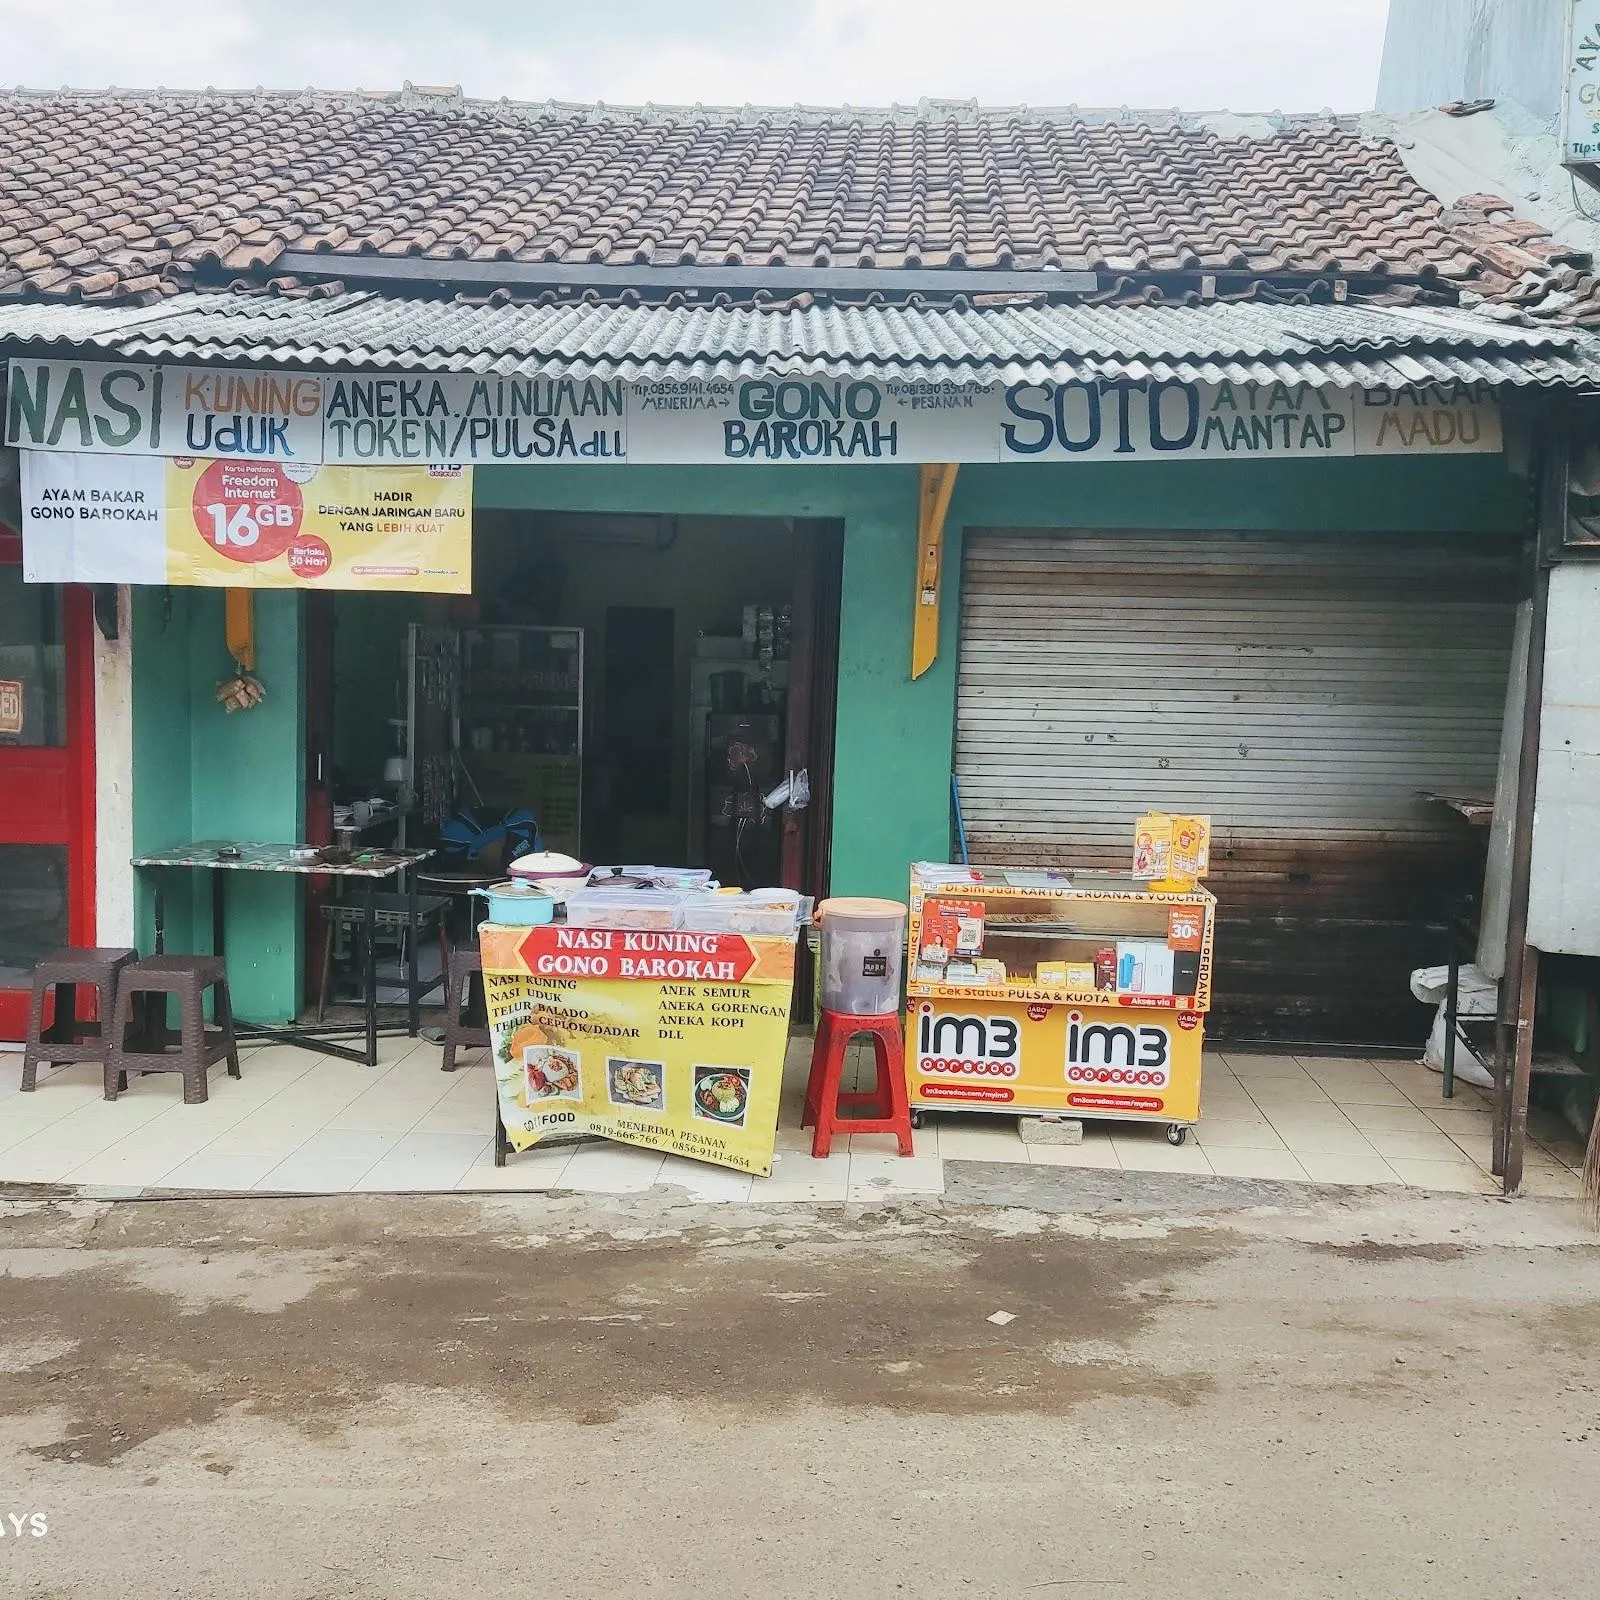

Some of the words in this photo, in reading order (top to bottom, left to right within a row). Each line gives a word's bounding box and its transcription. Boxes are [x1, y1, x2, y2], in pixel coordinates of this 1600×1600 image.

[185, 372, 321, 416] KUNING
[739, 381, 881, 420] GONO
[642, 396, 717, 410] MENERIMA
[912, 396, 973, 410] PESANAN
[1000, 379, 1200, 454] SOTO
[1201, 413, 1346, 451] MANTAP
[1376, 409, 1481, 447] MADU
[723, 420, 897, 459] BAROKAH
[222, 475, 279, 487] Freedom
[42, 489, 86, 502] AYAM
[91, 490, 145, 503] BAKAR
[225, 487, 276, 499] Internet
[374, 492, 413, 502] HADIR
[30, 507, 75, 519] GONO
[80, 507, 159, 521] BAROKAH
[318, 505, 369, 517] DENGAN
[372, 507, 432, 518] JARINGAN
[434, 508, 465, 518] BARU
[340, 522, 374, 532] YANG
[376, 523, 411, 533] LEBIH
[415, 524, 444, 534] KUAT
[556, 929, 613, 950] NASI
[624, 931, 719, 954] KUNING
[537, 954, 609, 976] GONO
[619, 958, 736, 981] BAROKAH
[488, 974, 521, 988] NASI
[525, 975, 577, 990] KUNING
[490, 988, 521, 1003] NASI
[526, 988, 562, 1003] UDUK
[659, 985, 696, 997] ANEK
[702, 987, 751, 998] SEMUR
[938, 987, 960, 996] Cek
[964, 988, 1005, 998] Status
[1008, 990, 1050, 1000] PULSA
[1053, 992, 1062, 1001] &
[1066, 992, 1111, 1004] KUOTA
[491, 1001, 532, 1018] TELUR
[537, 1003, 589, 1020] BALADO
[658, 1000, 705, 1012] ANEKA
[711, 1002, 787, 1018] GORENGAN
[658, 1015, 705, 1026] ANEKA
[711, 1017, 745, 1028] KOPI
[658, 1029, 684, 1040] DLL
[921, 1004, 1018, 1058] im3
[1068, 1012, 1168, 1067] im3
[920, 1057, 1016, 1077] ooredoo
[1068, 1066, 1166, 1086] ooredoo
[542, 1112, 575, 1125] FOOD
[617, 1119, 676, 1138] MENERIMA
[680, 1130, 727, 1149] PESANAN
